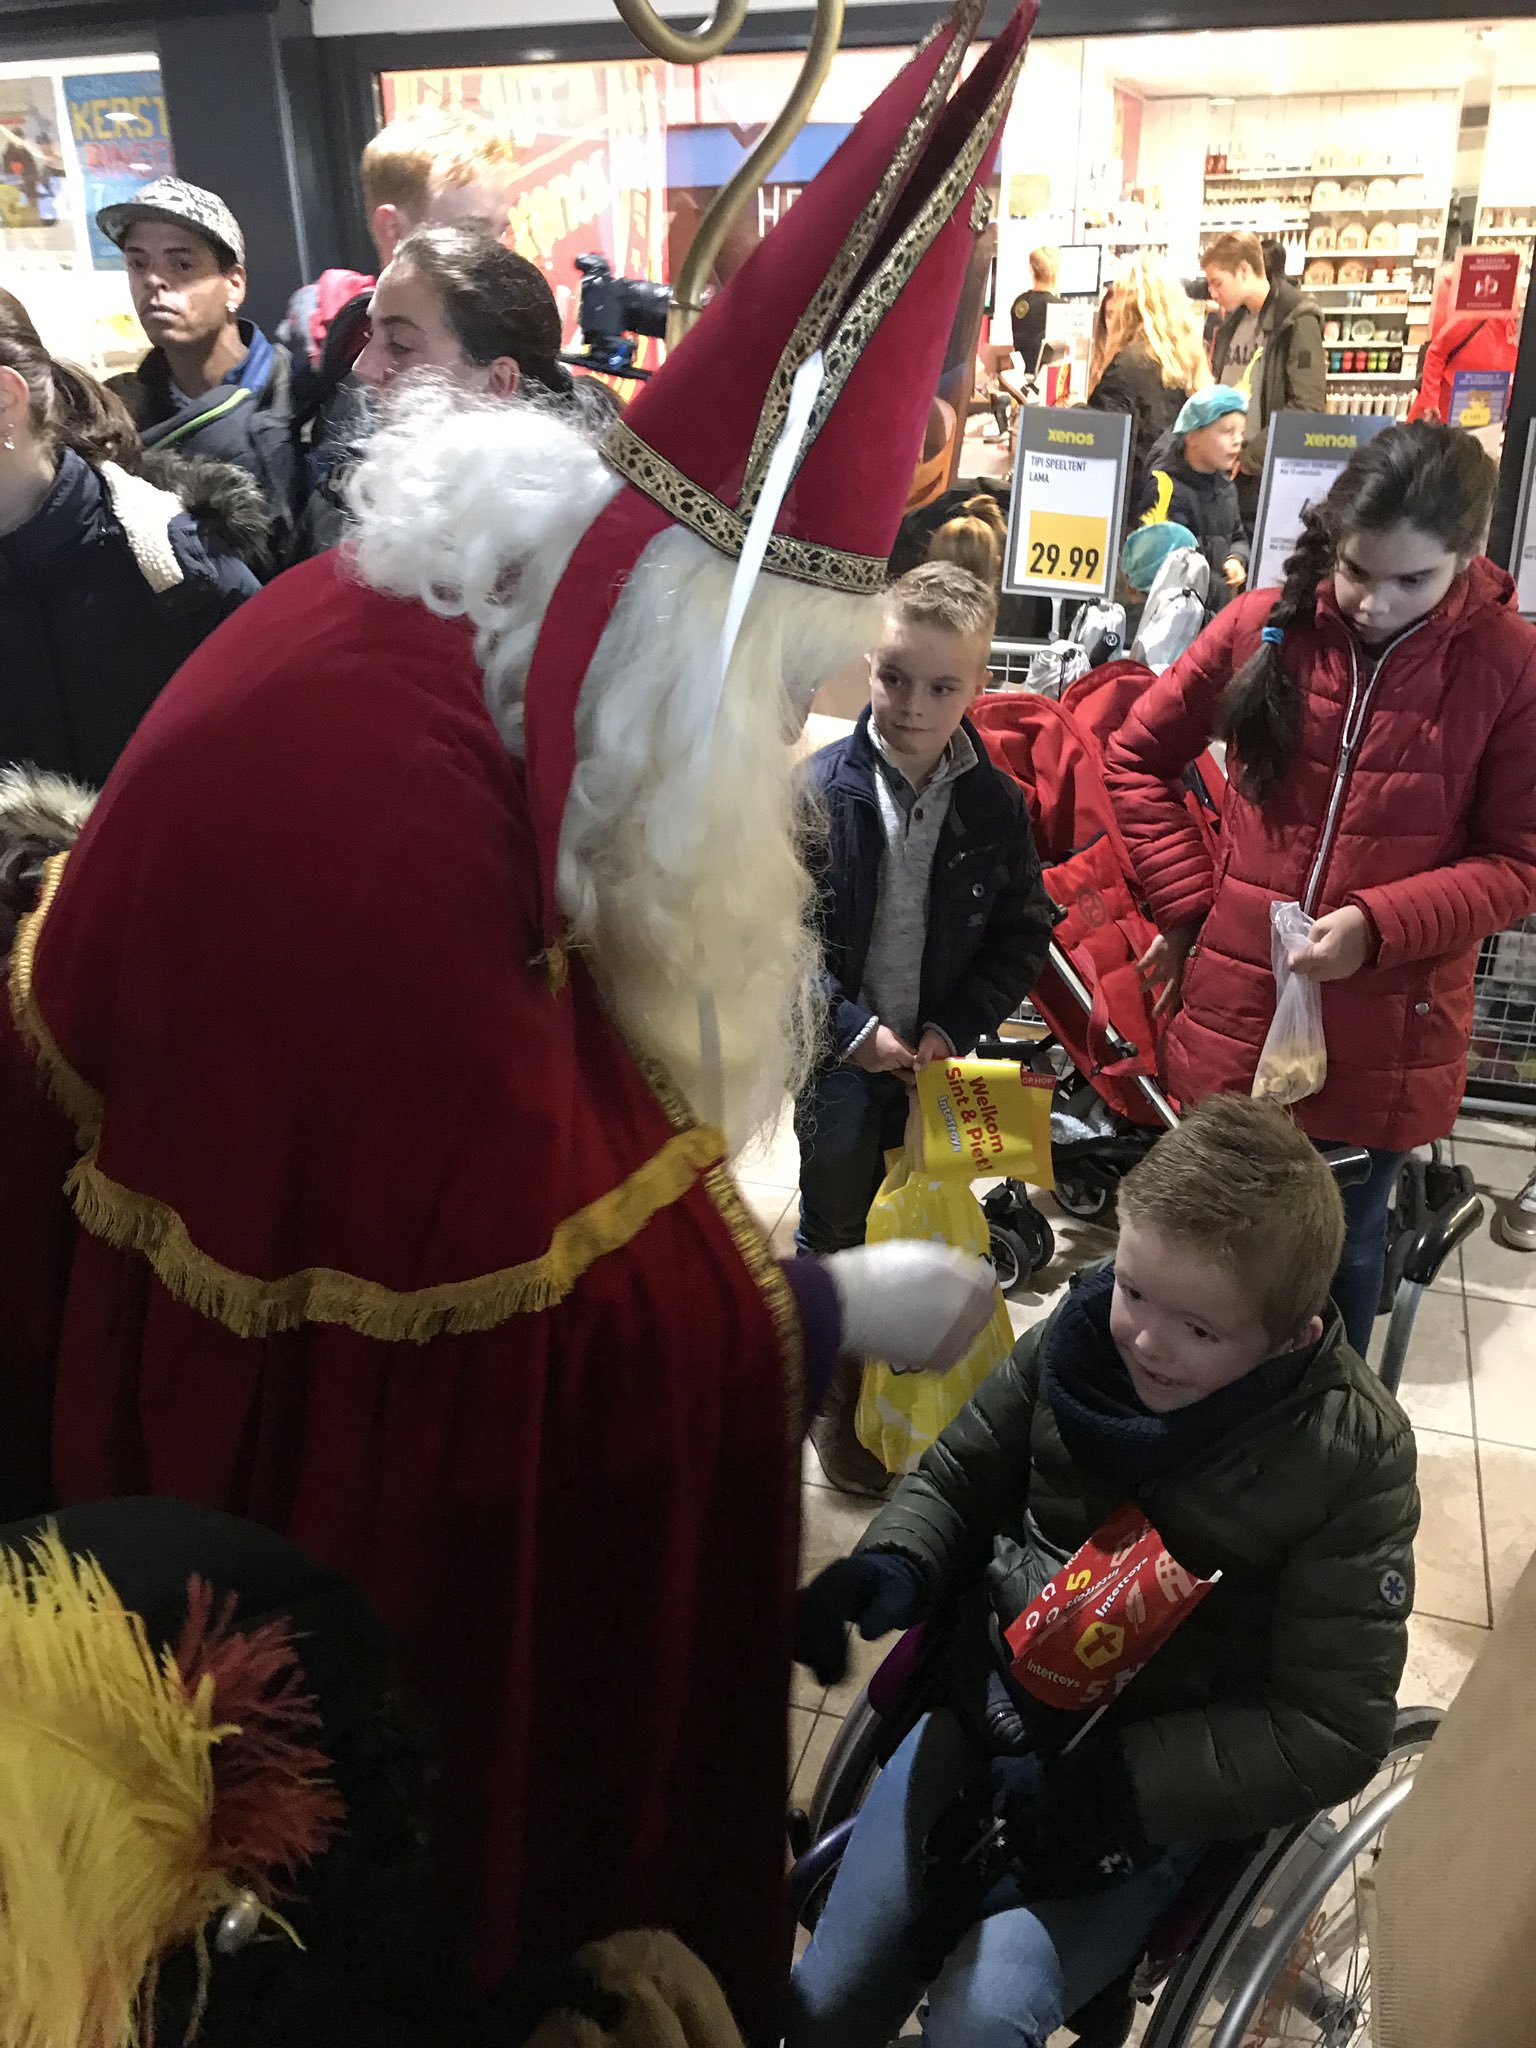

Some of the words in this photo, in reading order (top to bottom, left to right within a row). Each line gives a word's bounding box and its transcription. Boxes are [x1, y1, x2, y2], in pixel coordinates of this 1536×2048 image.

[69, 96, 170, 140] KERST
[1047, 428, 1095, 446] xenos
[1304, 433, 1357, 448] xenos
[1029, 472, 1050, 484] LAMA
[1030, 456, 1044, 468] TIPI
[1046, 457, 1086, 472] SPEELTENT
[1029, 542, 1100, 580] 29.99
[945, 1067, 969, 1107] Sint
[961, 1109, 977, 1124] &
[968, 1076, 1004, 1154] Welkom
[966, 1127, 994, 1172] Piet!
[1065, 1569, 1092, 1591] 5
[1094, 1556, 1149, 1618] Intertoys
[1026, 1657, 1082, 1689] Intertoys
